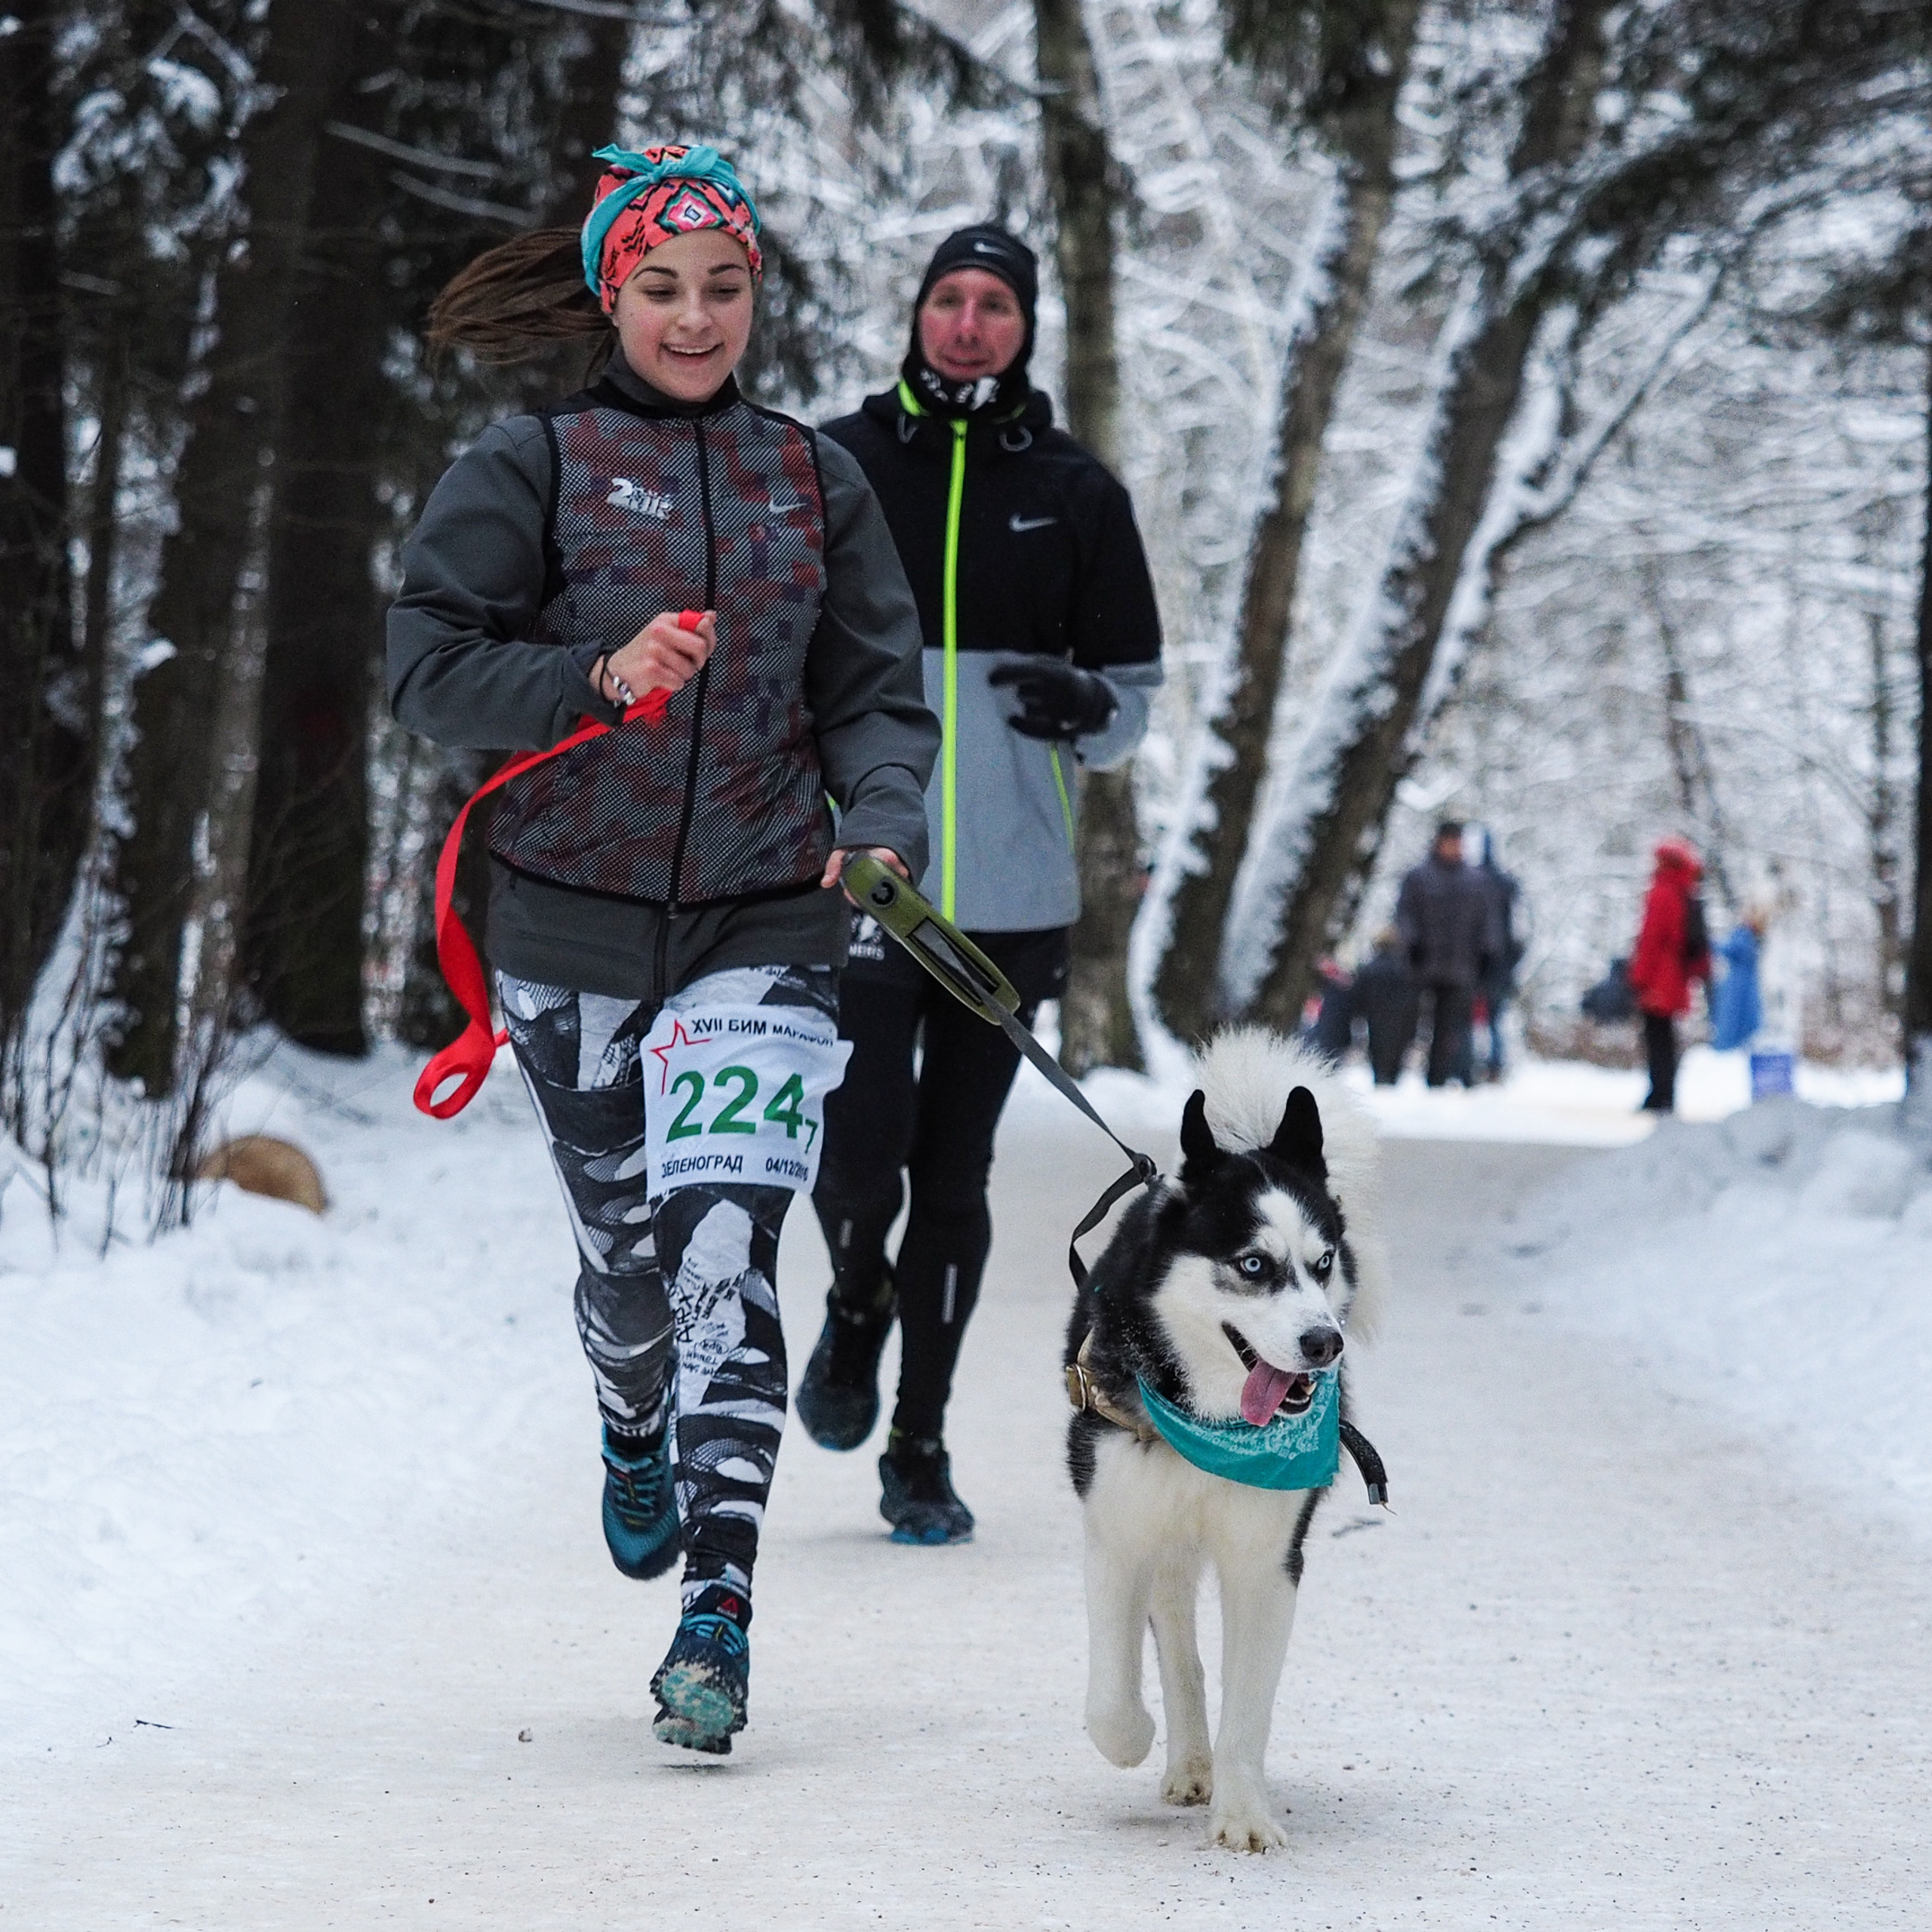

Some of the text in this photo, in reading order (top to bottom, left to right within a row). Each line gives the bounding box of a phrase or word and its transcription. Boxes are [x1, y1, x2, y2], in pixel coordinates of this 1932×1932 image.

[692, 1019, 722, 1033] XVII
[728, 1020, 767, 1035] БИМ
[662, 1155, 743, 1178] ЗЕЛЕНОГРАД
